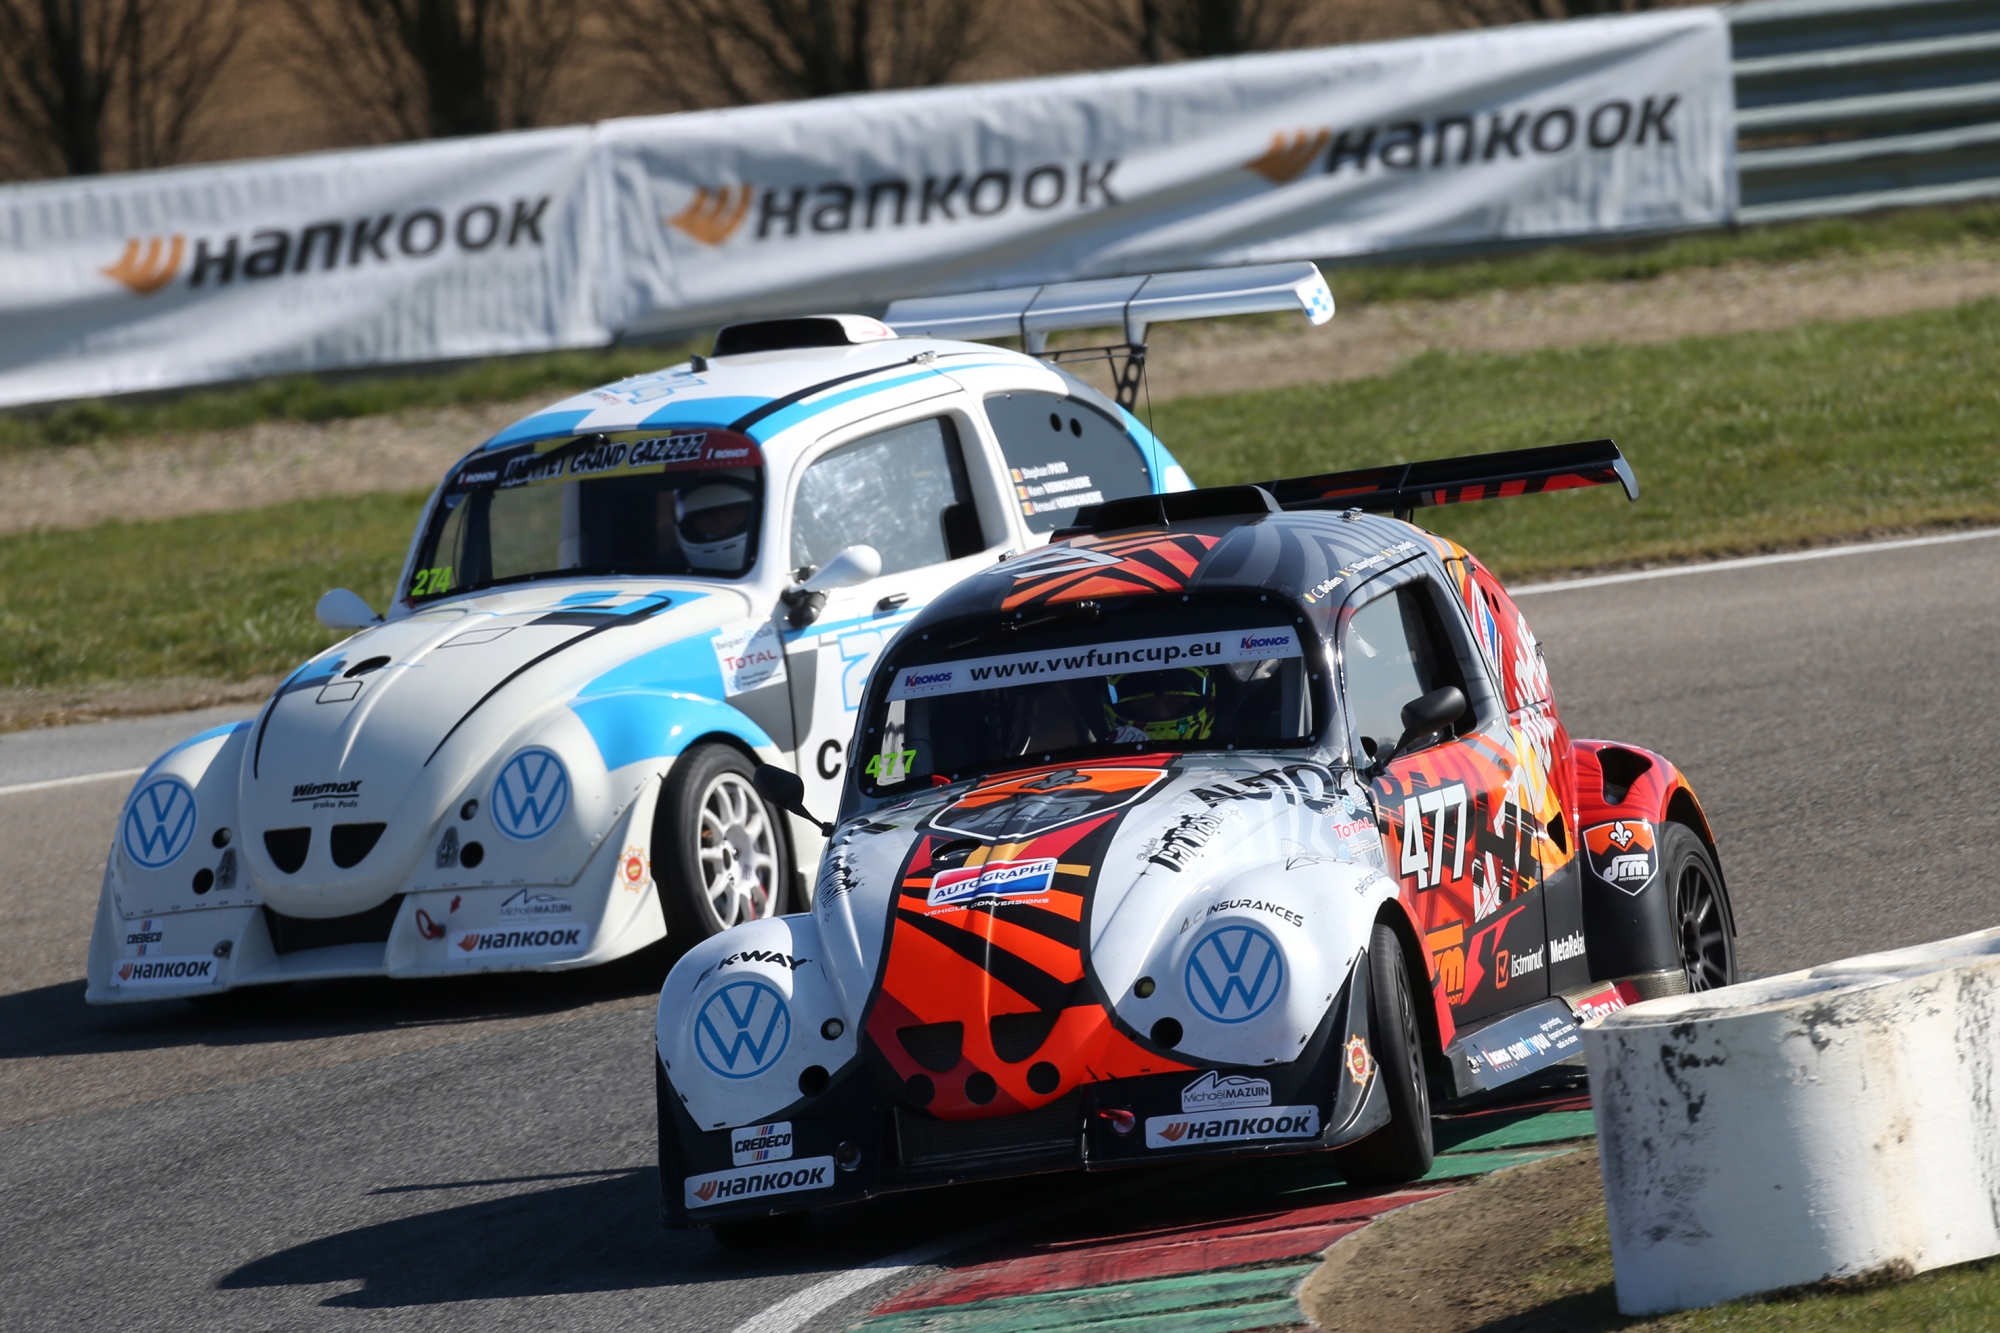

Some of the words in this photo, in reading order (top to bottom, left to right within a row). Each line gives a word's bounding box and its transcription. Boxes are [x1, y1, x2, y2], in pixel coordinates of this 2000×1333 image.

[411, 566, 453, 597] 274
[969, 640, 1222, 682] www.vwfuncup.eu
[864, 750, 917, 778] 477
[338, 799, 359, 809] Pads
[1400, 782, 1468, 890] 477
[933, 861, 1054, 900] AUTOGRAPHE
[923, 903, 968, 917] VEHICLE
[970, 897, 1050, 910] CONVERSIONS
[1206, 899, 1304, 928] INSURANCES
[126, 931, 163, 945] CREDECO
[717, 949, 808, 971] K-WAY
[733, 1132, 792, 1154] CREDECO
